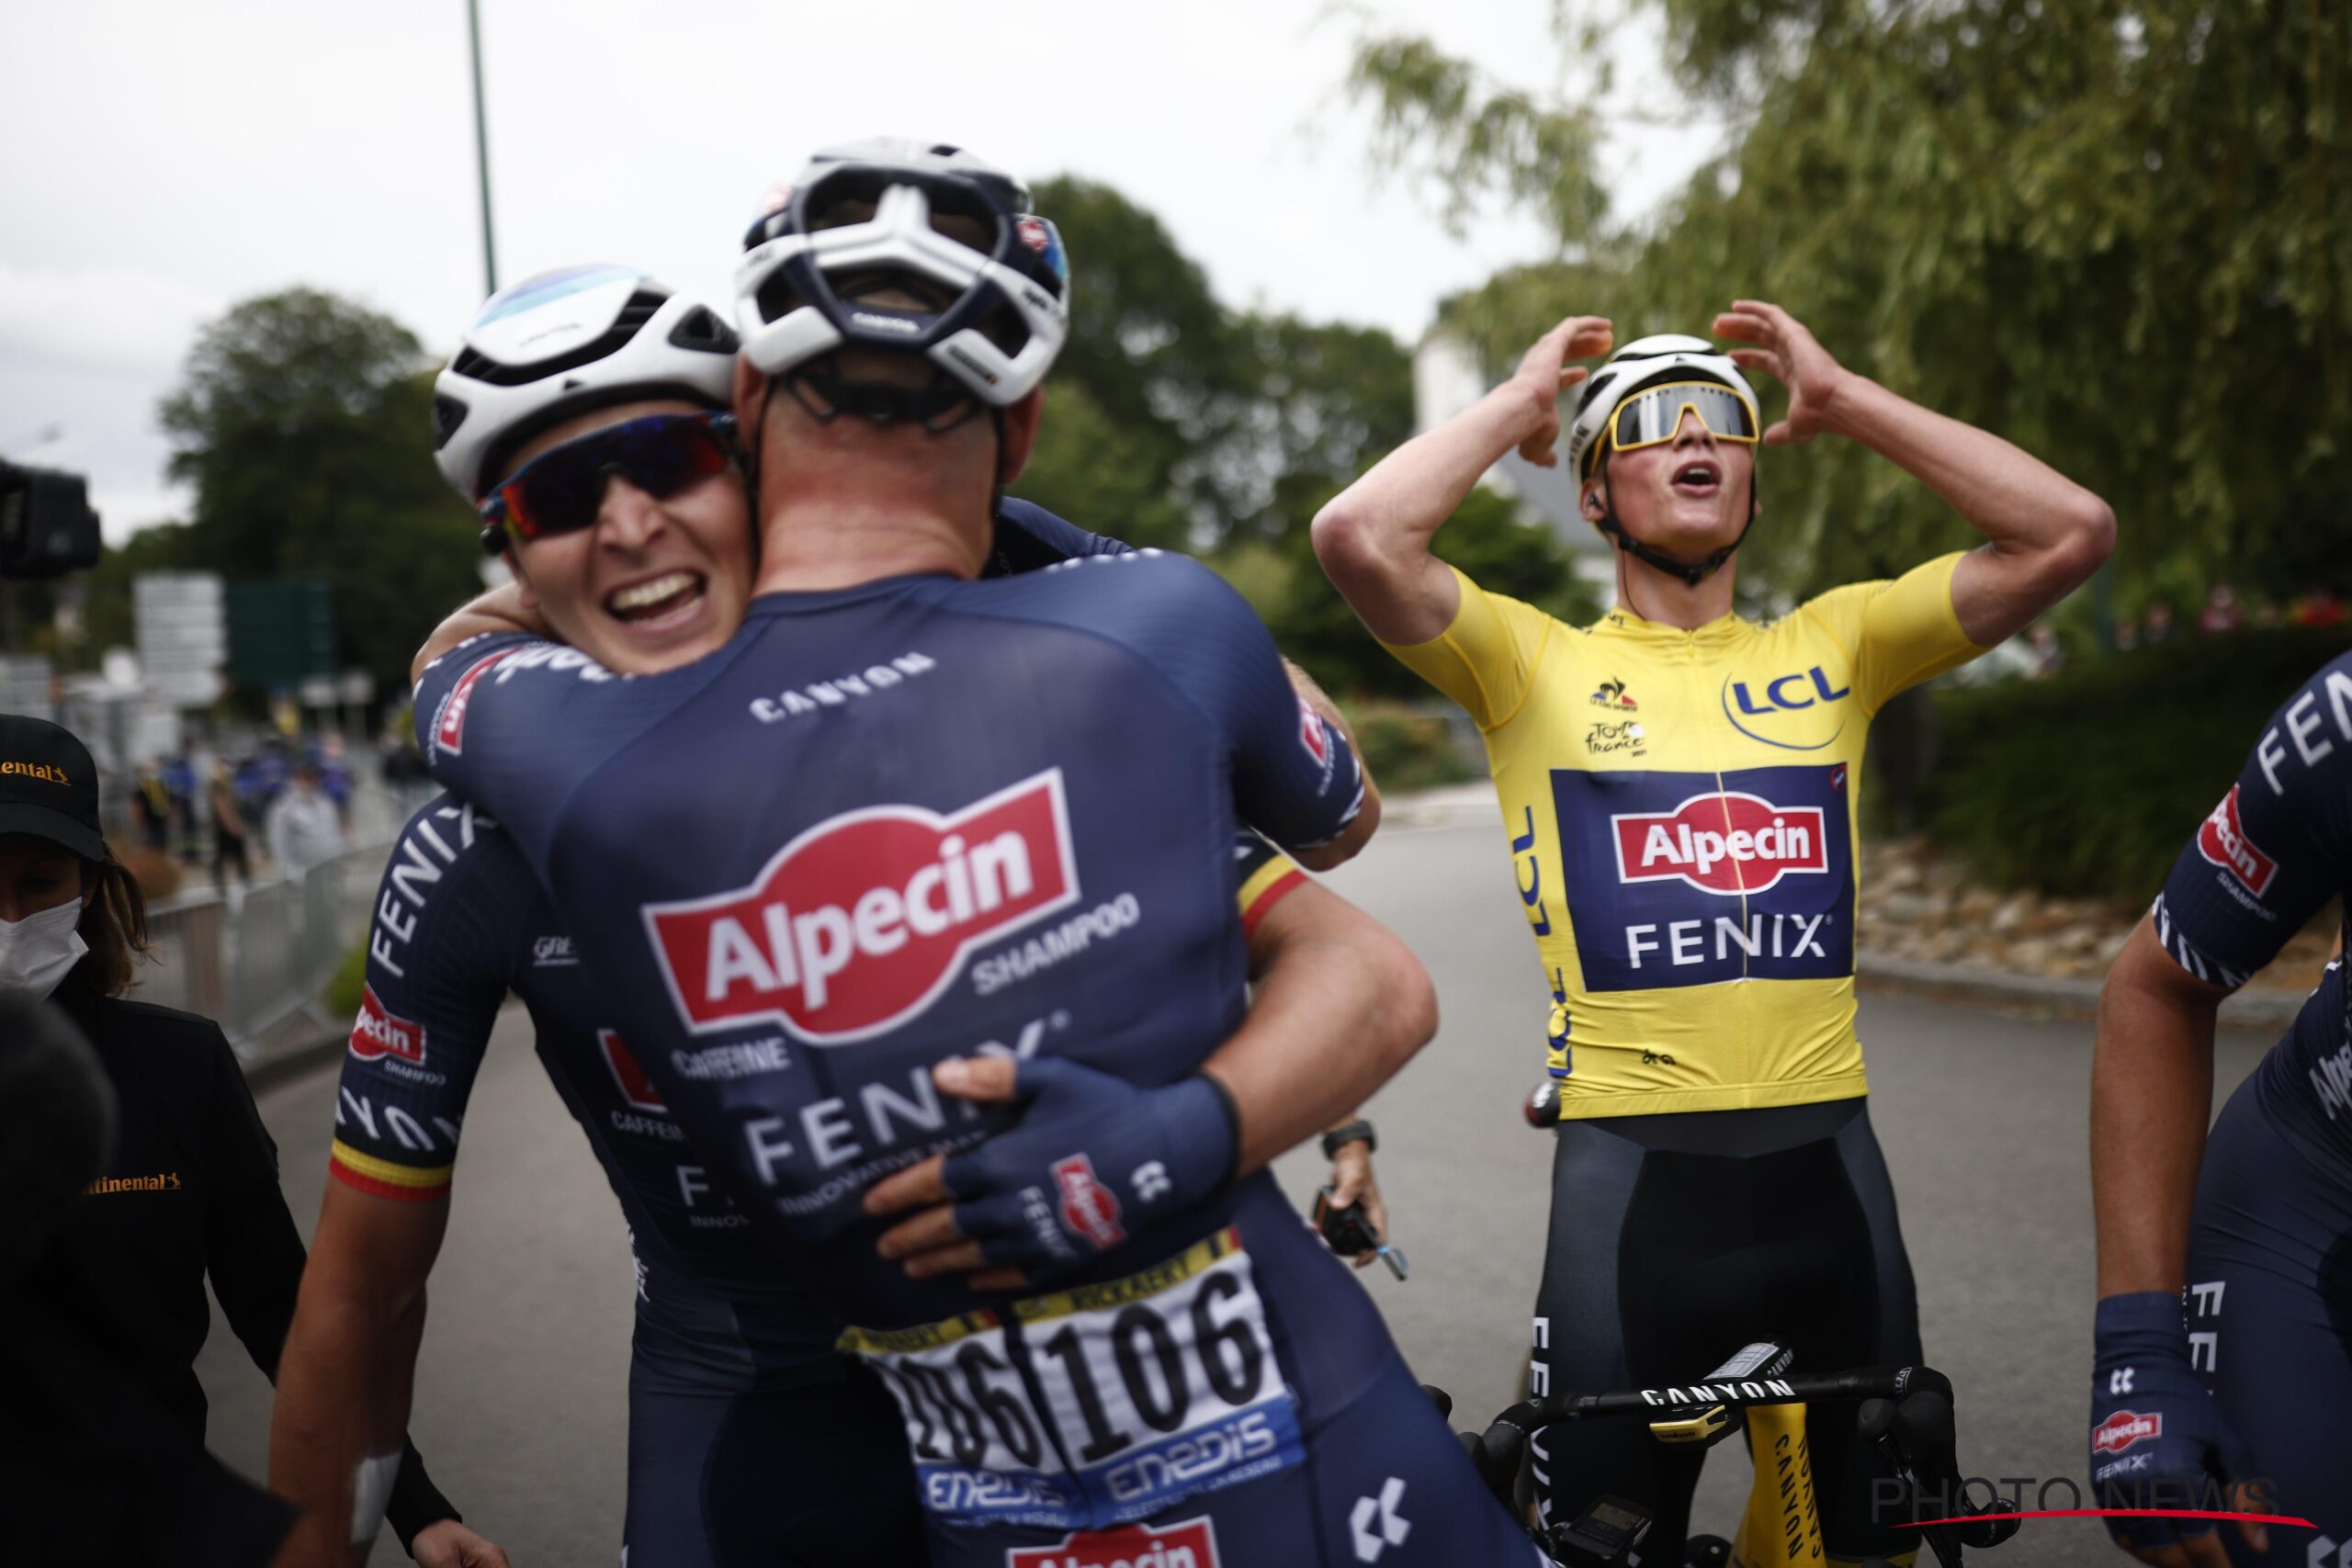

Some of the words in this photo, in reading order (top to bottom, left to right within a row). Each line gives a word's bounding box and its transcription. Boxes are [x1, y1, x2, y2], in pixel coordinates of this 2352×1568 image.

[749, 651, 936, 724] CANYON
[1733, 666, 1850, 716] LCL
[0, 760, 52, 782] ental
[2258, 671, 2352, 796] FEN
[370, 802, 498, 978] FENIX
[1512, 806, 1551, 936] LCL
[1641, 817, 1811, 875] Alpecin
[706, 829, 1033, 1012] Alpecin
[971, 892, 1141, 996] SHAMPOO
[1625, 914, 1826, 970] FENIX
[1046, 1270, 1263, 1463] 106
[1641, 1380, 1796, 1405] CANYON
[2096, 1418, 2154, 1447] Alpecin
[1775, 1433, 1804, 1561] CANYON
